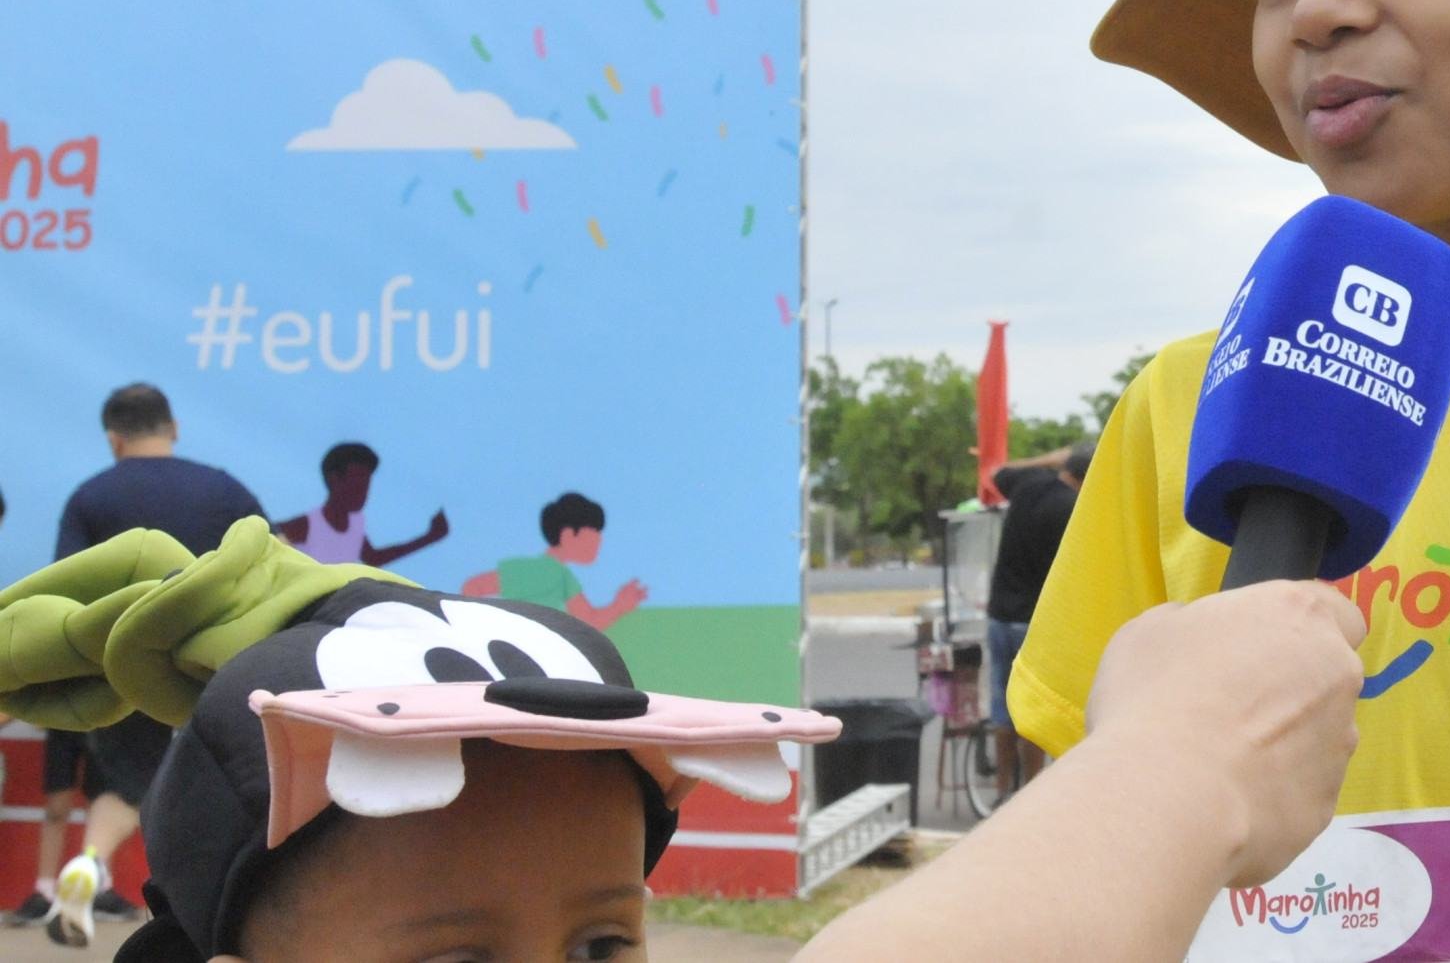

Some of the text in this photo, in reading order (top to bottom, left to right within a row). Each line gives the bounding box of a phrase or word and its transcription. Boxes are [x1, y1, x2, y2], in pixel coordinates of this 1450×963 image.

[187, 275, 492, 372] #eufui
[1343, 282, 1401, 328] CB
[1262, 336, 1427, 427] BRAZILIENSE
[1296, 319, 1416, 389] CORREIO
[1341, 912, 1379, 930] 2025
